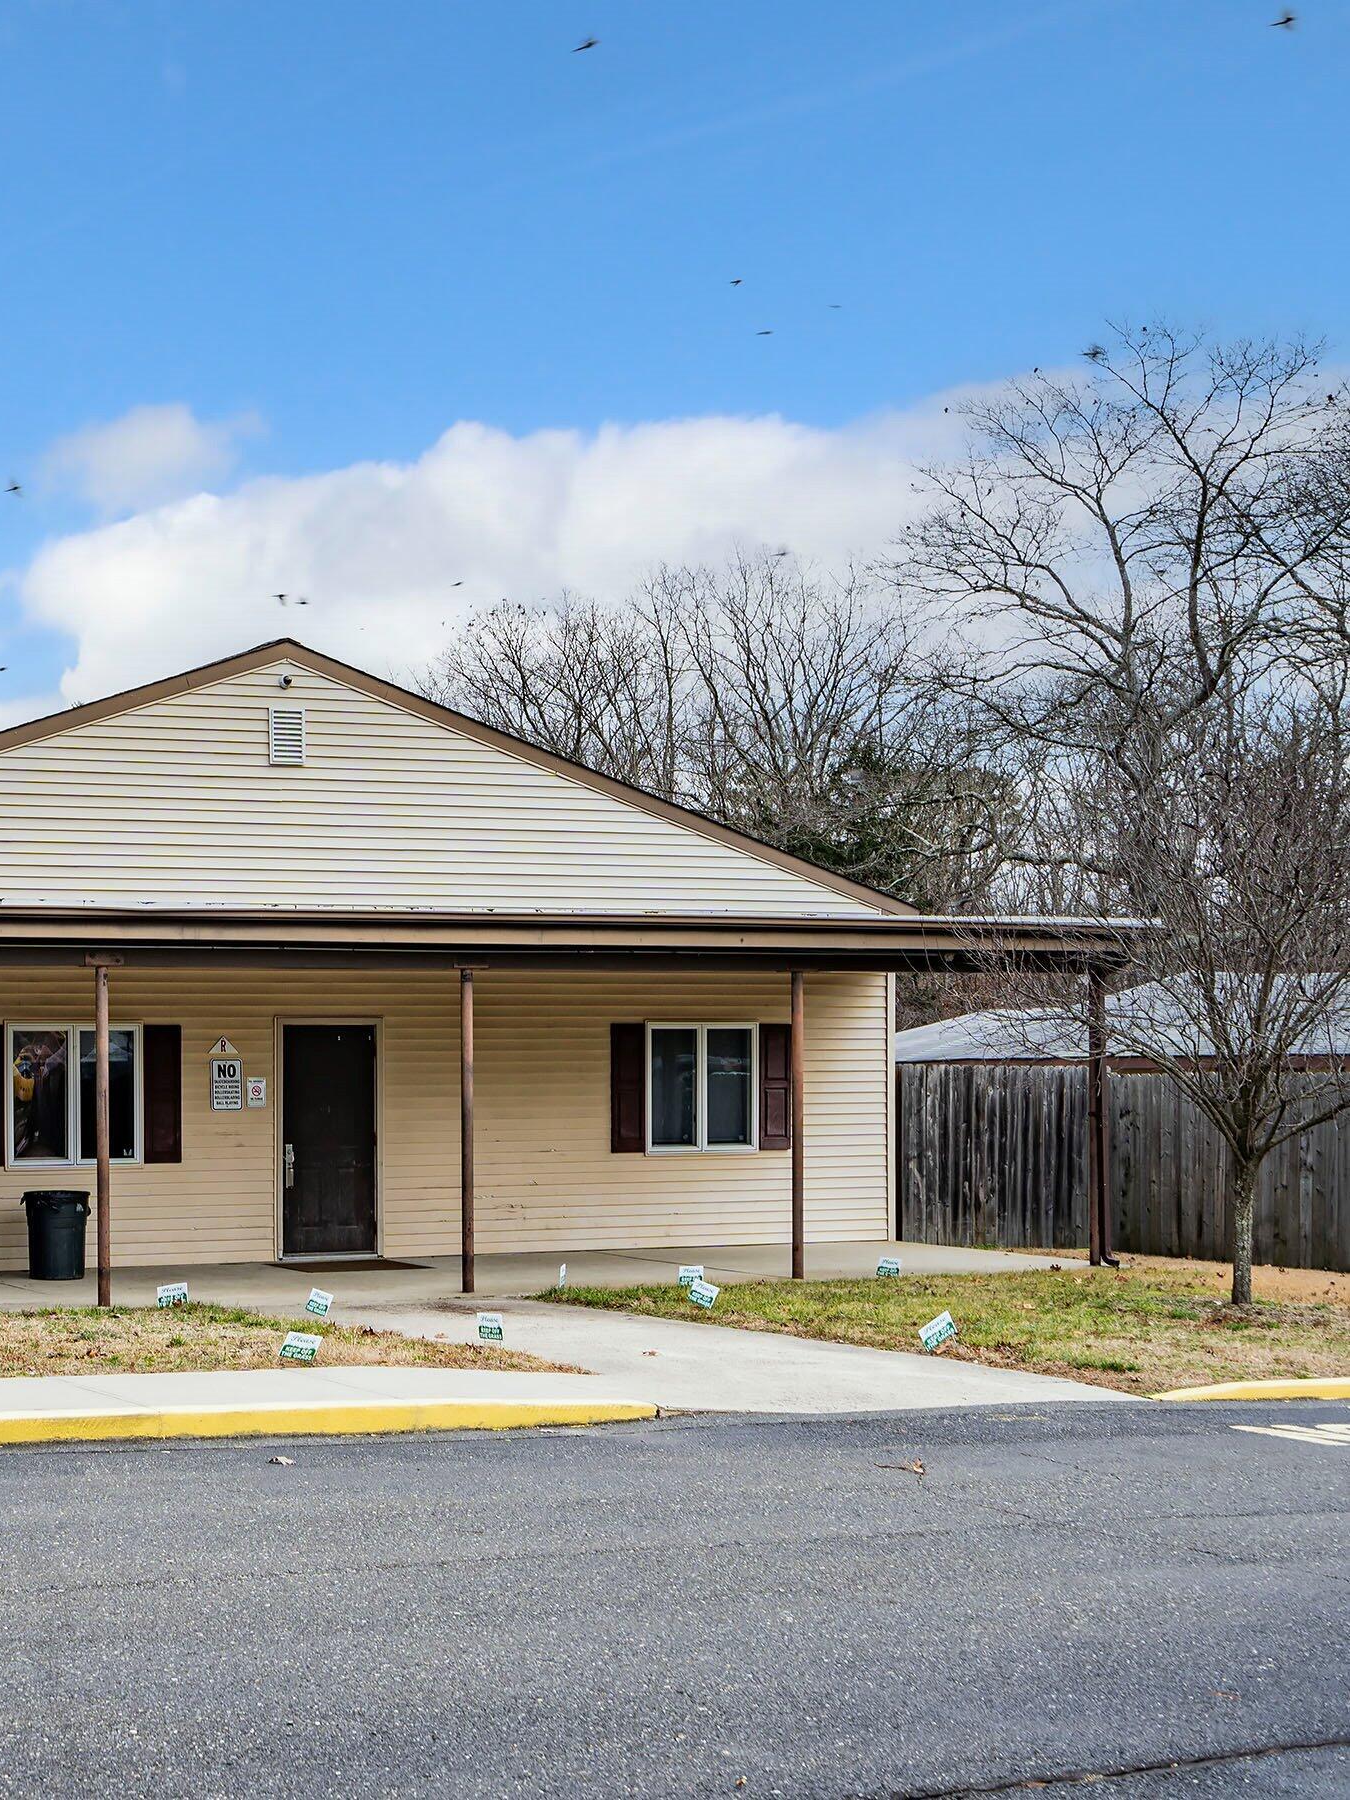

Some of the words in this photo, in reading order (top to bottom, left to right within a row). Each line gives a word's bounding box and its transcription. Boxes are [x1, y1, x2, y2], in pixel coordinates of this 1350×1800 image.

[220, 1039, 227, 1053] R
[217, 1063, 237, 1079] NO
[291, 1335, 316, 1345] Please
[281, 1350, 293, 1358] THE
[293, 1353, 313, 1361] GRASS
